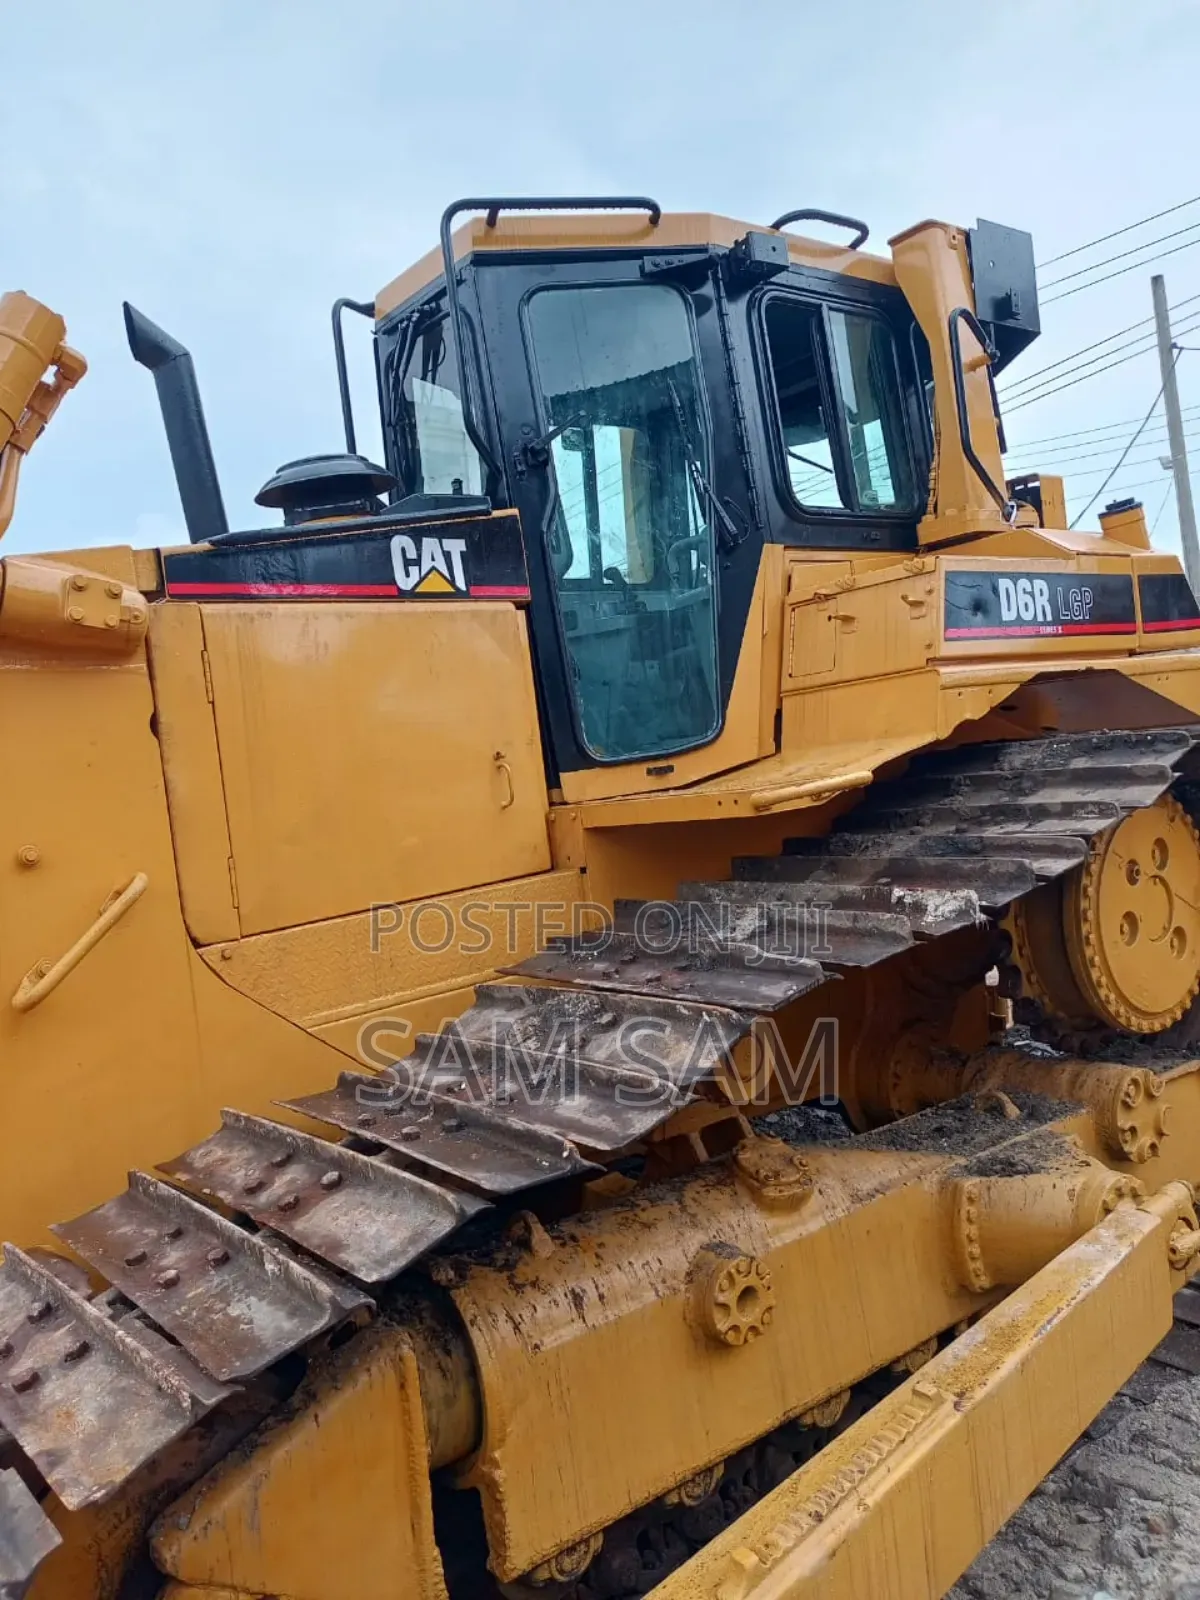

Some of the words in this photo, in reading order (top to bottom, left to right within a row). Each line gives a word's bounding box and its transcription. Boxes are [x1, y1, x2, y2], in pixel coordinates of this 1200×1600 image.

[390, 535, 467, 591] CAT
[998, 578, 1053, 622] D6R
[1057, 587, 1094, 620] LGP
